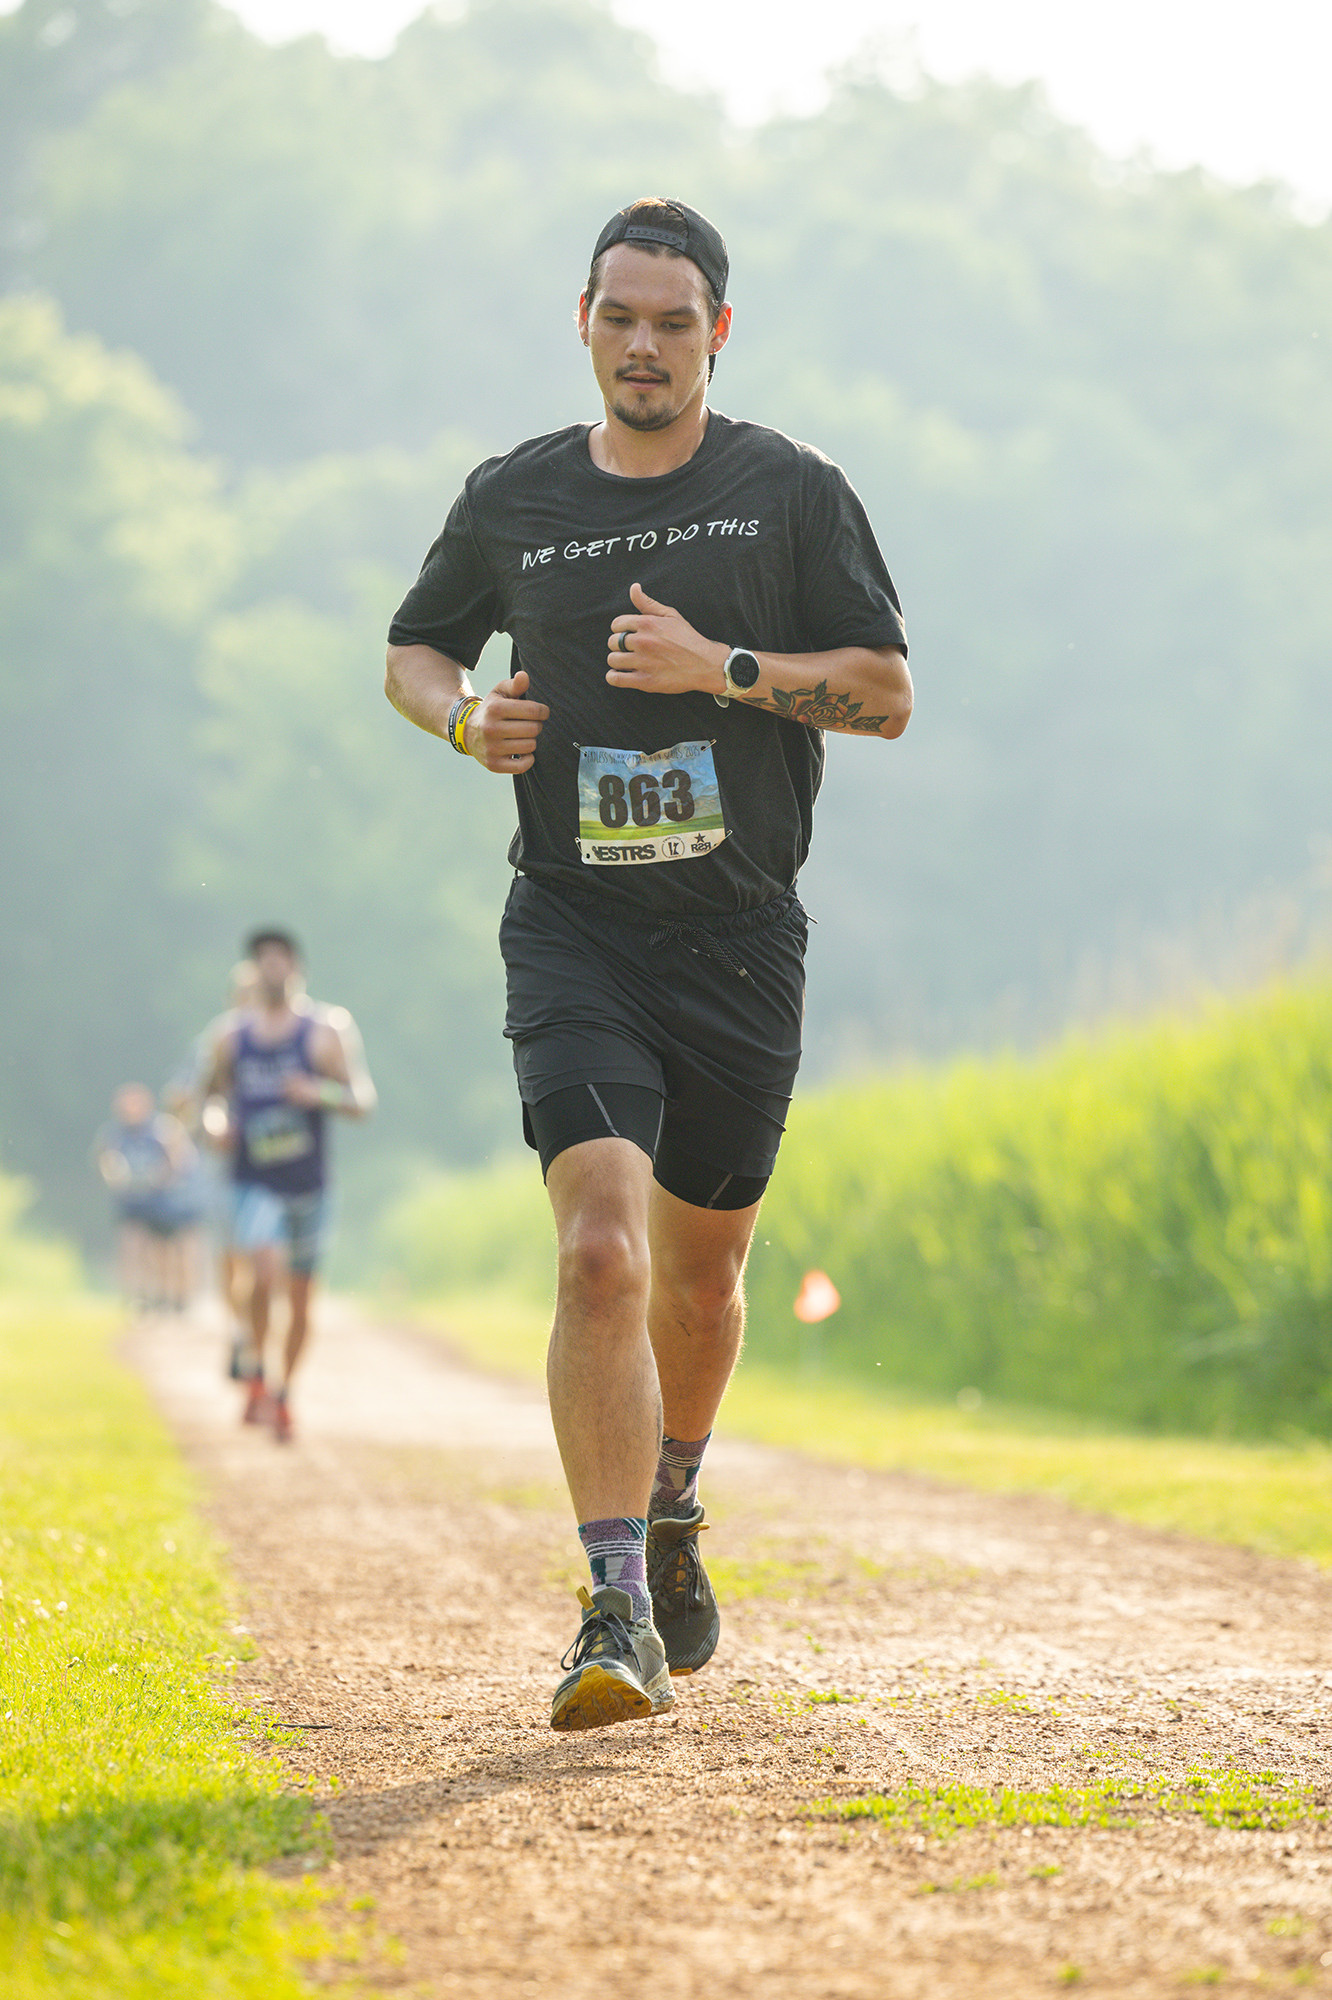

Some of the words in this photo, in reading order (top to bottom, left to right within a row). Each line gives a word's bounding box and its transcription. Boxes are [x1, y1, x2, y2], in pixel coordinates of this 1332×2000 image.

[522, 546, 555, 570] WE
[563, 537, 621, 560] GET
[626, 530, 657, 551] TO
[666, 523, 699, 546] DO
[706, 518, 760, 537] THIS
[598, 769, 696, 829] 863
